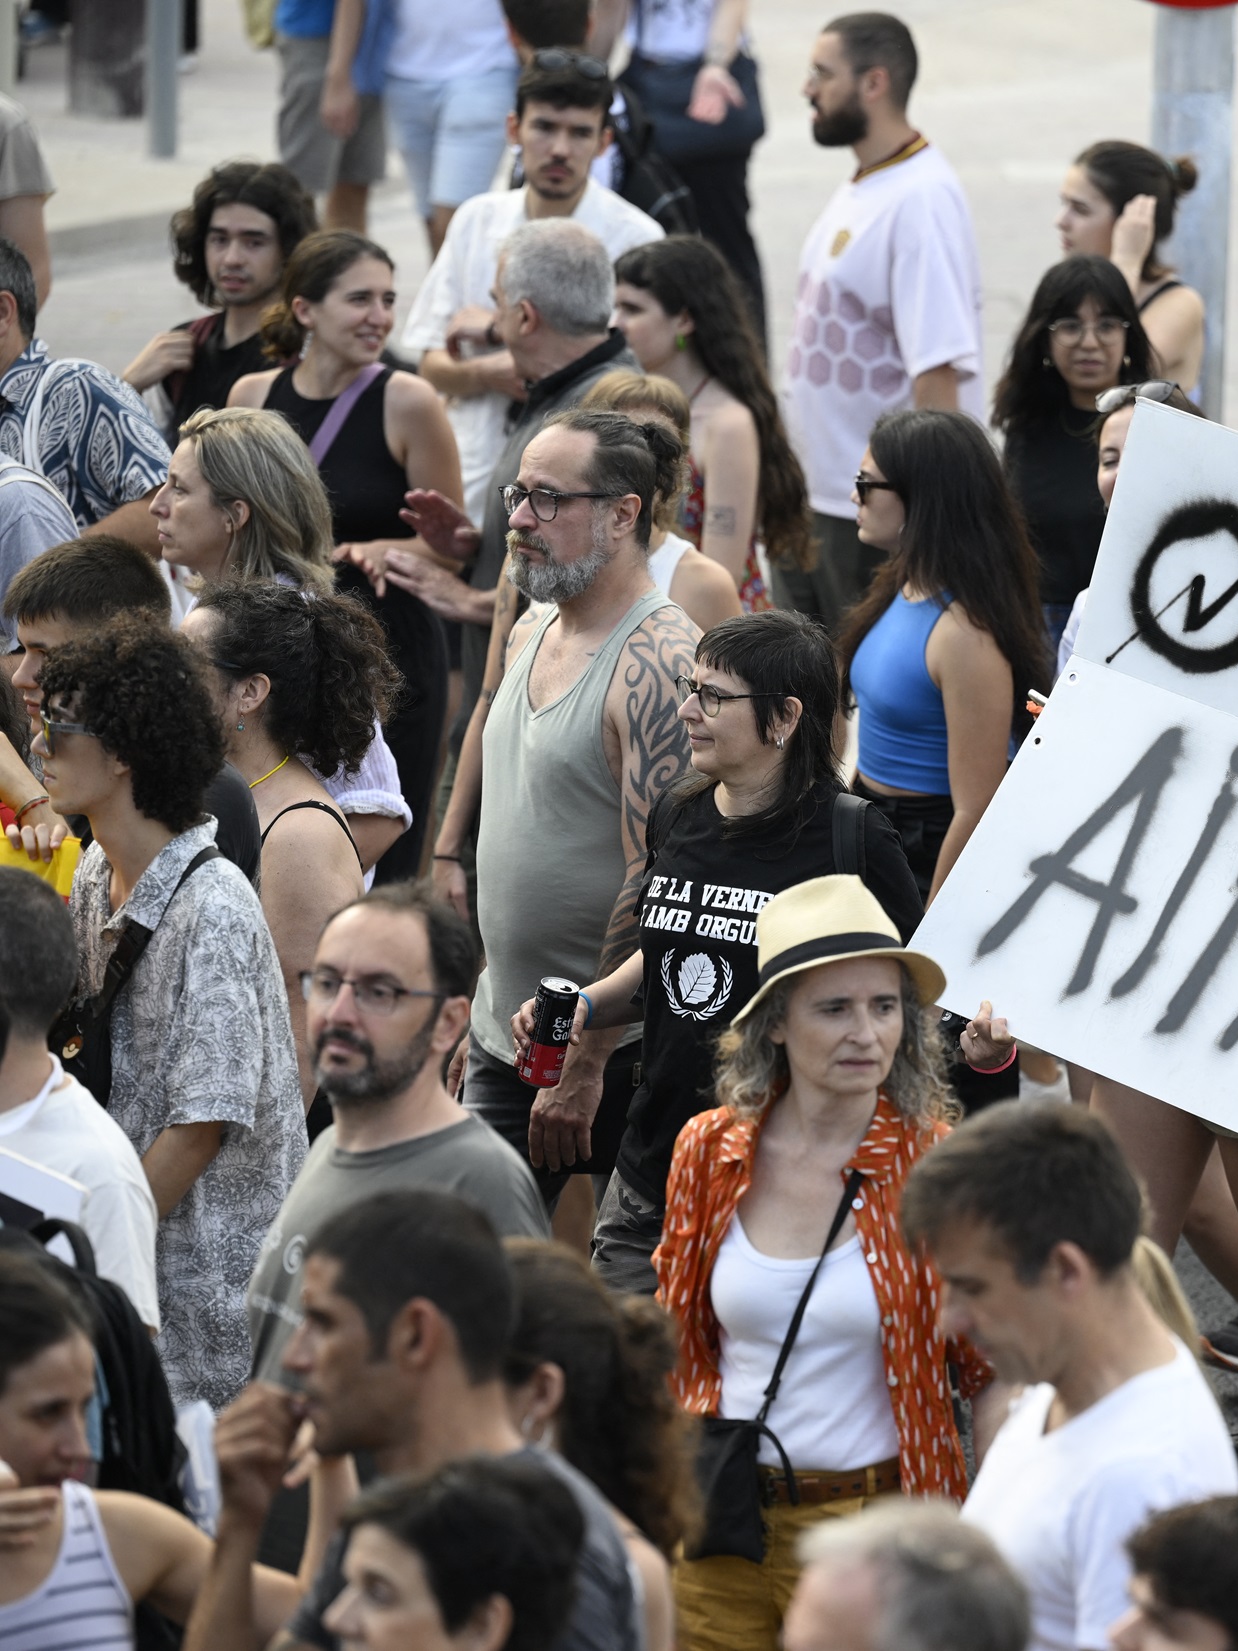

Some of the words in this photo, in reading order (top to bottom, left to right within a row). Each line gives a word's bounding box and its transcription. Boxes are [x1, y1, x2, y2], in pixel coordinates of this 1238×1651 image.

[647, 875, 668, 898] DE
[665, 877, 694, 904] LA
[700, 884, 776, 914] VERNE
[644, 905, 693, 934] AMB
